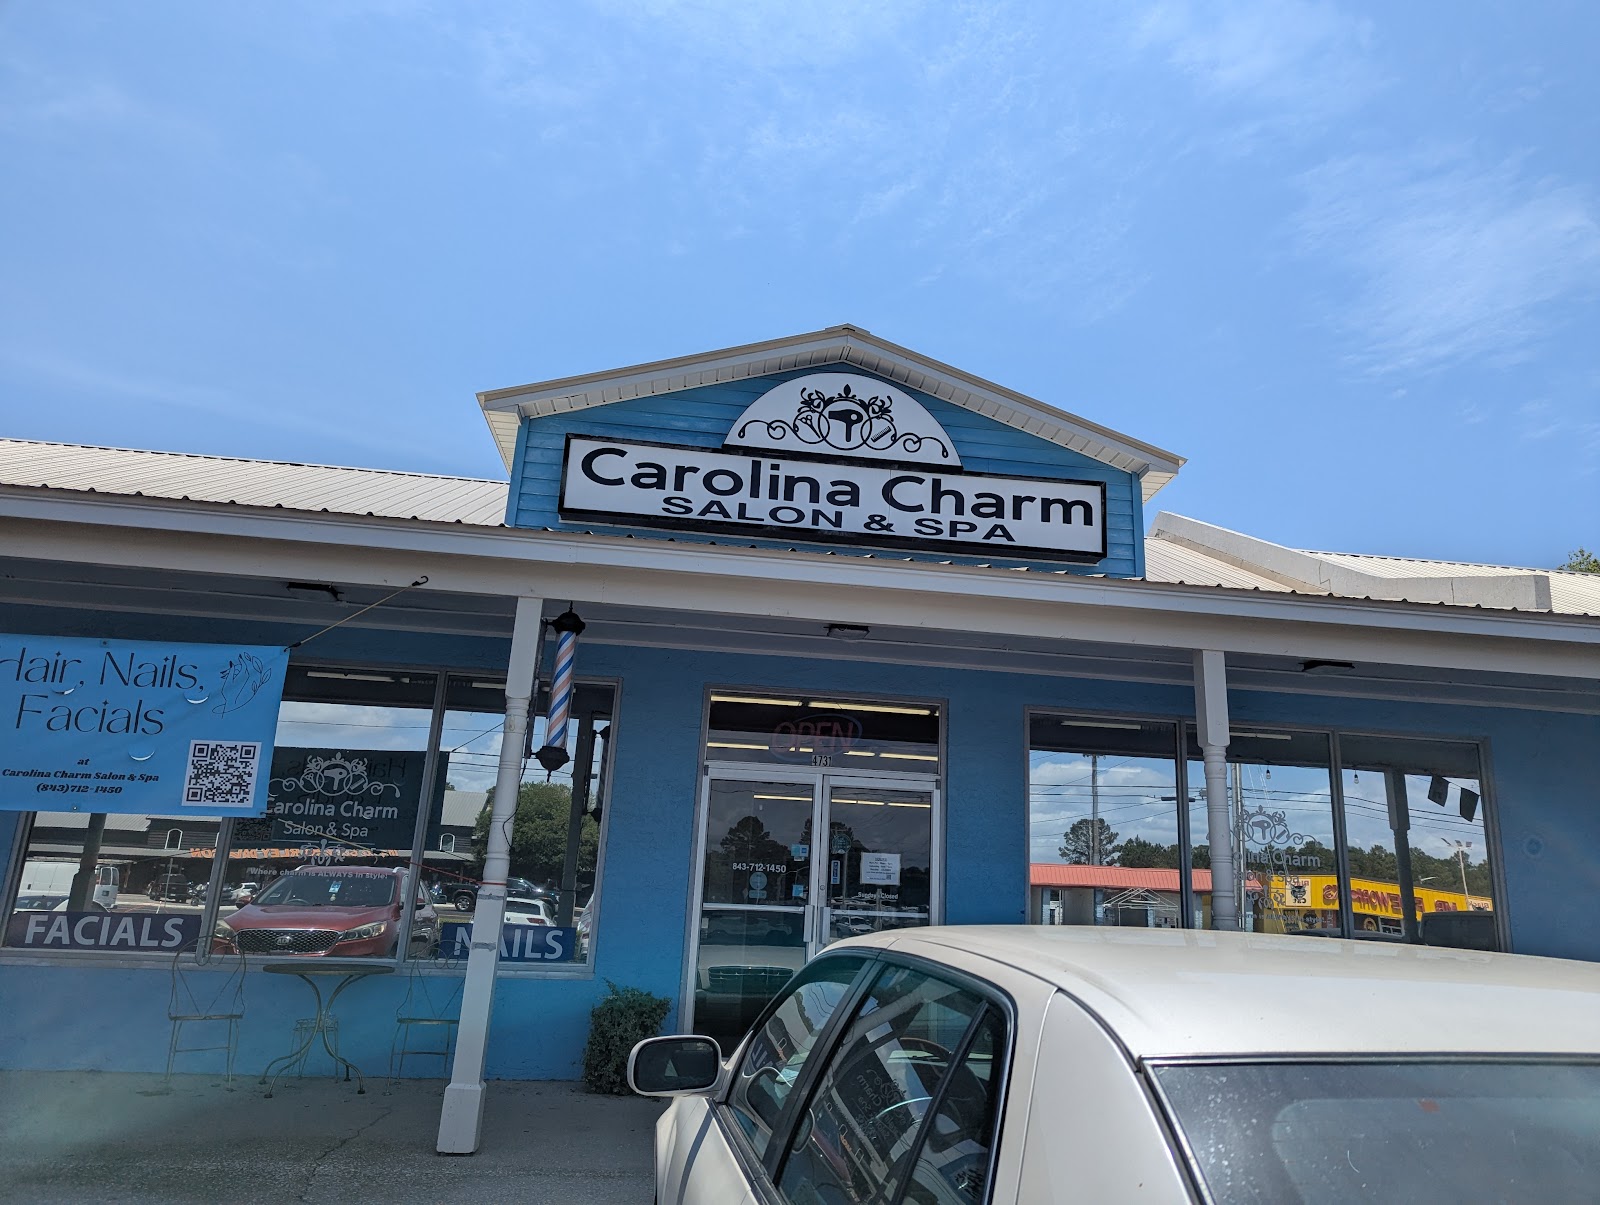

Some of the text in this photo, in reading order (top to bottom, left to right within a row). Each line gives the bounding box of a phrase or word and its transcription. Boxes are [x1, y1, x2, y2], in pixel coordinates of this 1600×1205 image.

[581, 447, 1093, 526] Carolina Charm
[661, 496, 1016, 542] SALON & SPA
[100, 651, 204, 693] Nails,
[16, 694, 164, 735] Facials
[772, 721, 854, 753] OPEN
[77, 758, 90, 766] at
[812, 755, 832, 767] 4731
[2, 769, 159, 783] Carolina Charm Salon & Spa
[266, 797, 335, 817] arolina
[340, 800, 399, 819] Charm
[283, 821, 369, 839] Salon & Spa
[732, 862, 787, 873] 843-712-1450
[1272, 849, 1321, 867] Charm
[857, 892, 877, 900] Sunday
[880, 892, 899, 900] Closed
[24, 914, 184, 948] FACIALS
[453, 926, 564, 959] NILS
